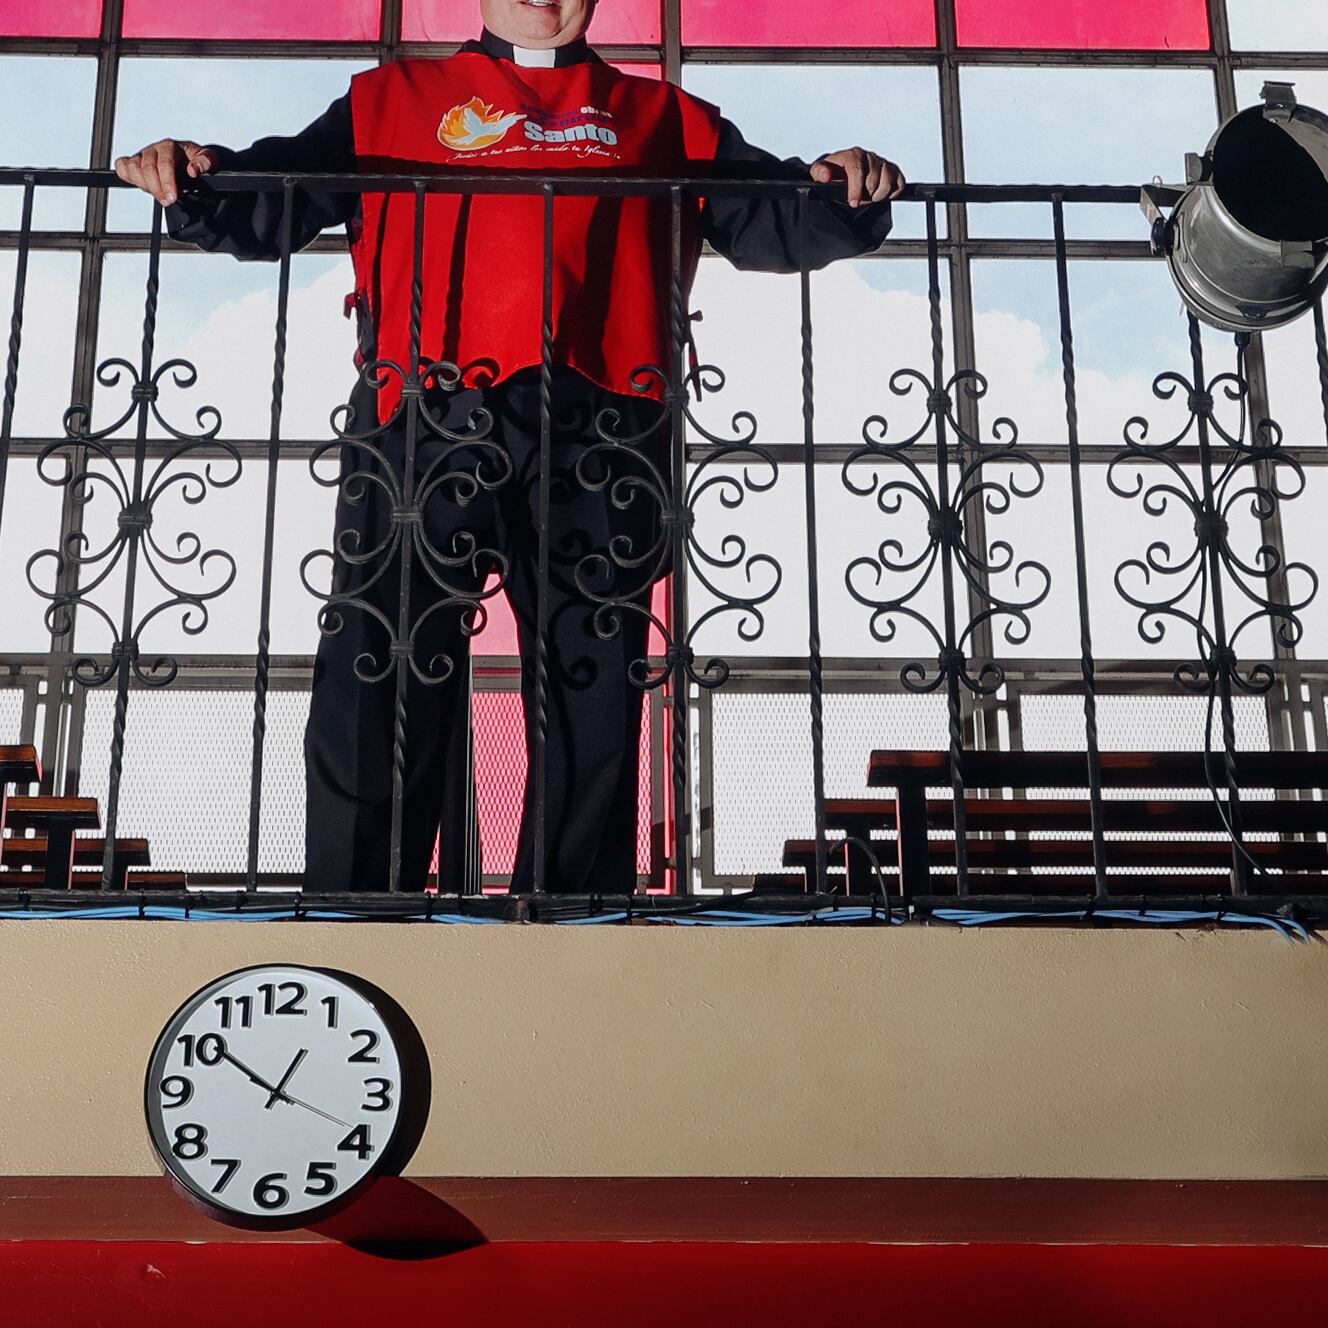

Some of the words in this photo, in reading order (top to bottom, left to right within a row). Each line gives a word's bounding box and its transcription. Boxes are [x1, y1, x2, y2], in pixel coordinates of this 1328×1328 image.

[523, 120, 618, 146] Santo
[214, 996, 253, 1028] 11
[258, 982, 307, 1015] 12
[320, 996, 337, 1028] 1
[177, 1033, 227, 1067] 10
[347, 1029, 380, 1063] 2
[160, 1075, 194, 1108] 9
[361, 1077, 393, 1111] 3
[172, 1122, 208, 1160] 8
[337, 1124, 374, 1160] 4
[210, 1159, 241, 1193] 7
[253, 1172, 289, 1209] 6
[304, 1162, 337, 1196] 5
